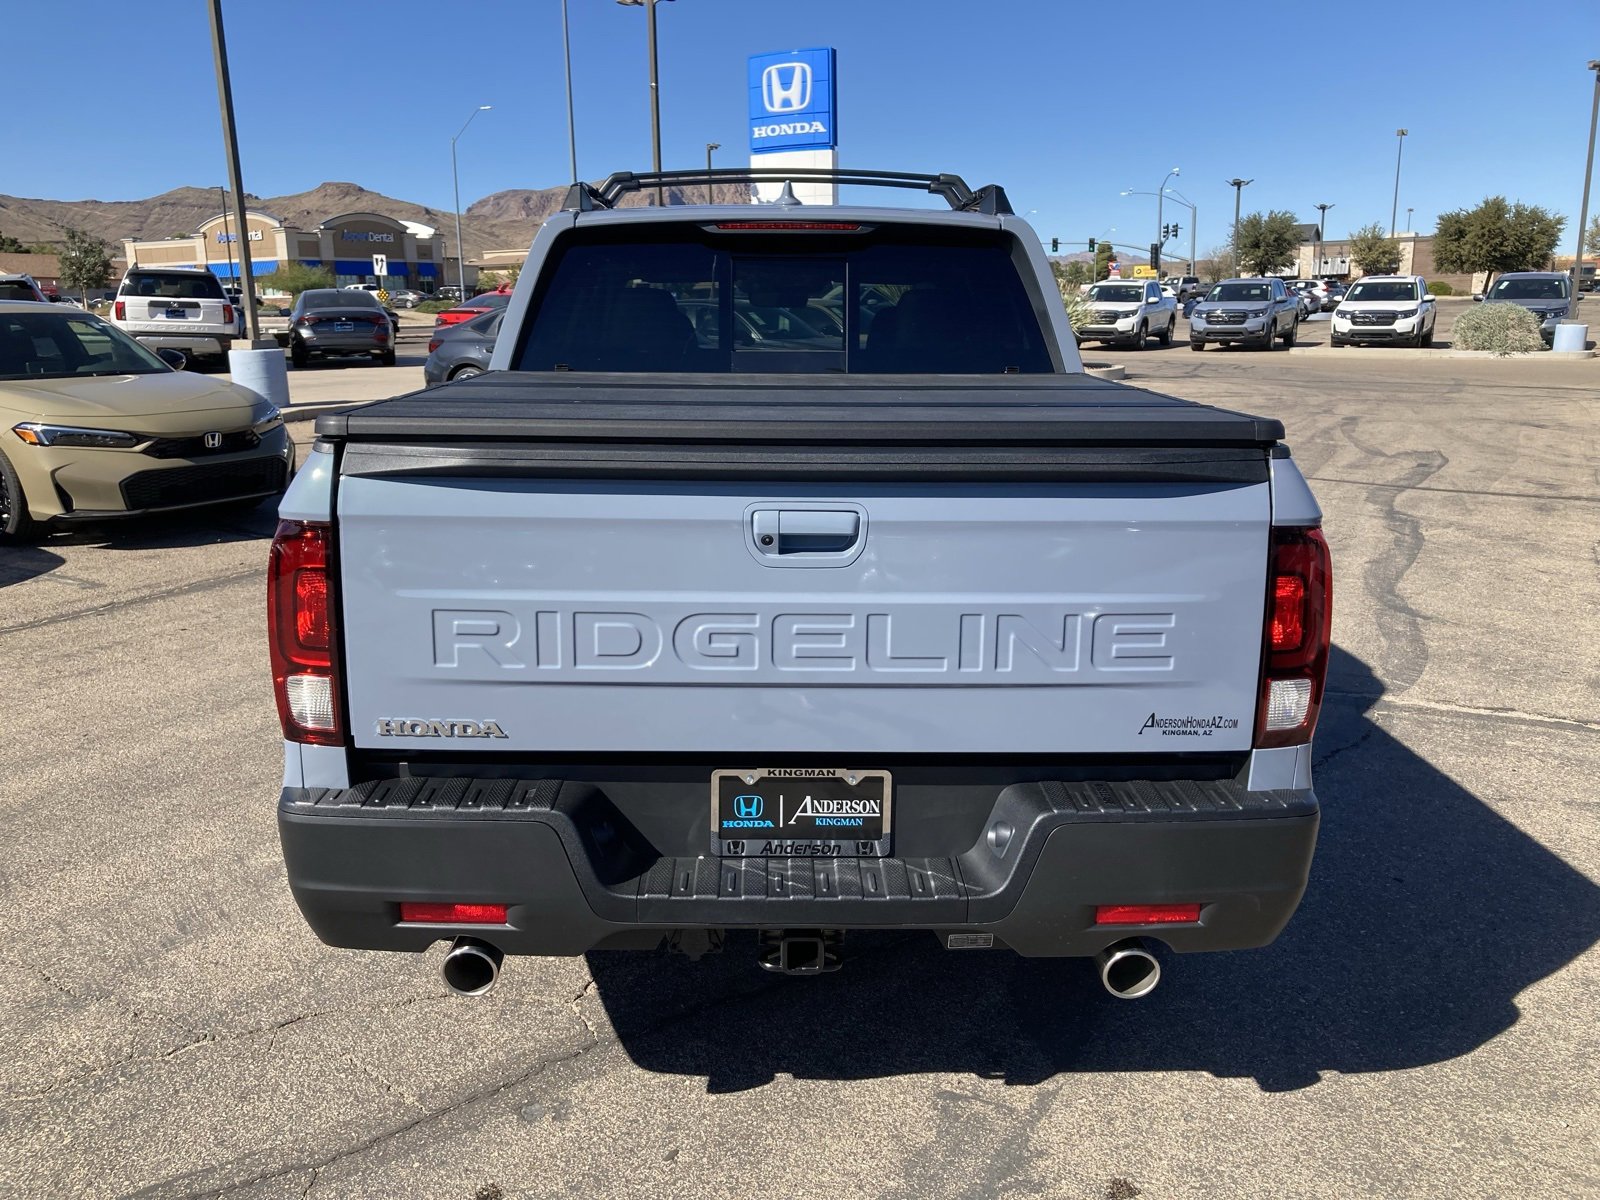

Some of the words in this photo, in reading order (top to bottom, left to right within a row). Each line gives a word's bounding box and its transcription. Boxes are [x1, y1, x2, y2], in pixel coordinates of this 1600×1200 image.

[752, 121, 827, 138] HONDA
[431, 608, 1176, 672] RIDGELINE
[375, 716, 509, 739] HONDA
[767, 769, 836, 777] KINGMAN
[788, 795, 880, 824] ANDERSON
[722, 820, 774, 828] HONDA
[815, 817, 863, 826] KINGMAN
[760, 841, 842, 855] Anderson
